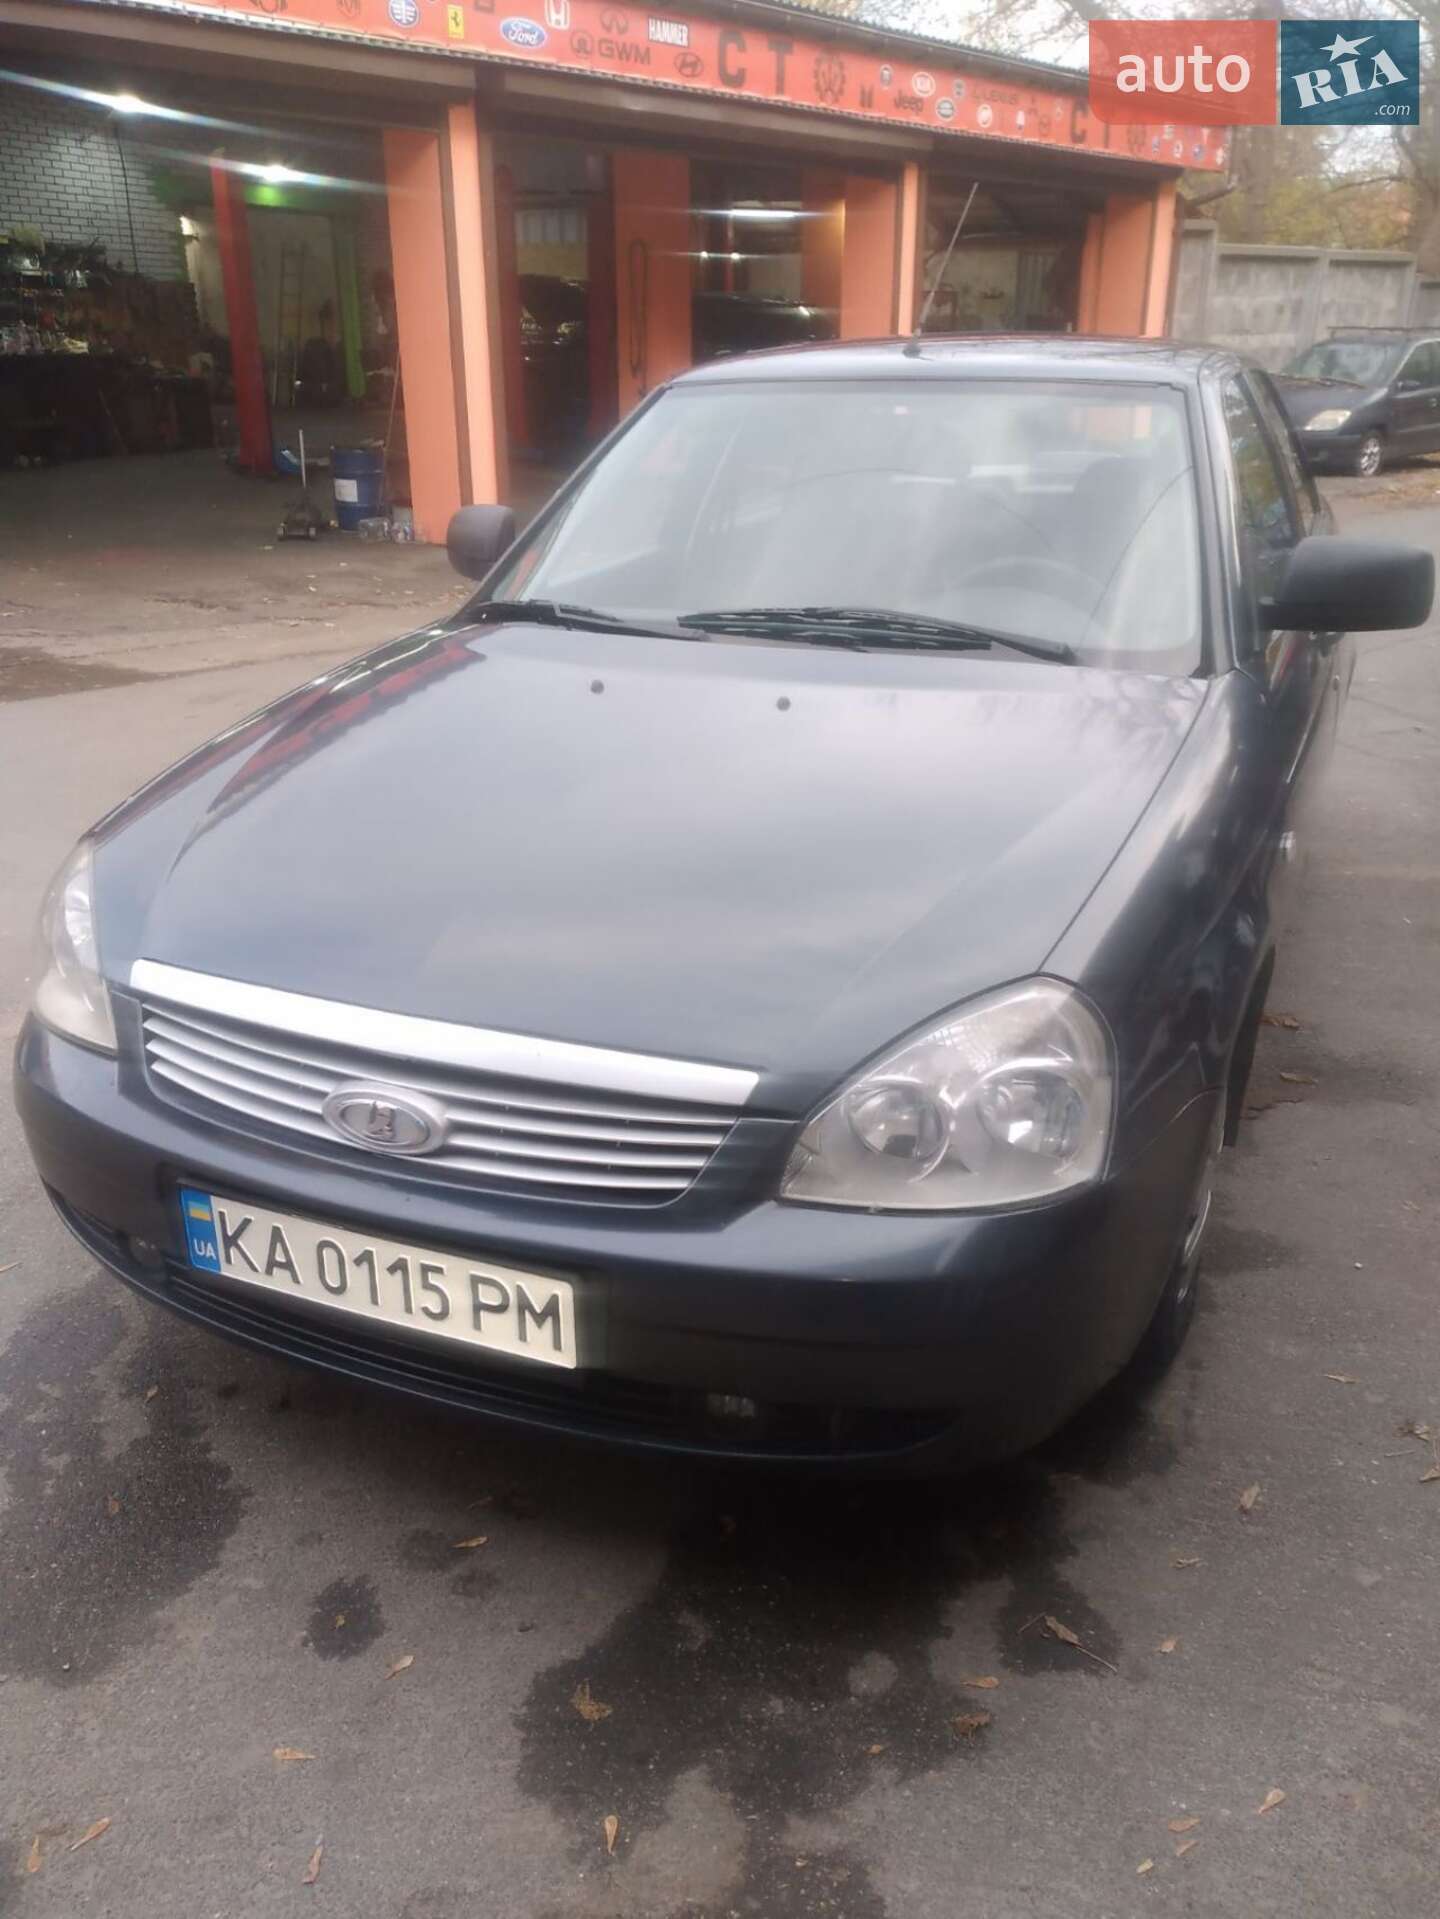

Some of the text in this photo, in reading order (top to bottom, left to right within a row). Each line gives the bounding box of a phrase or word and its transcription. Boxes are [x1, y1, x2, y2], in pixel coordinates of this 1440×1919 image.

[507, 20, 539, 45] Ford
[648, 18, 688, 47] HAMMER
[598, 38, 651, 65] GWM
[193, 1239, 217, 1261] UA
[218, 1210, 563, 1352] KA 0115 PM
